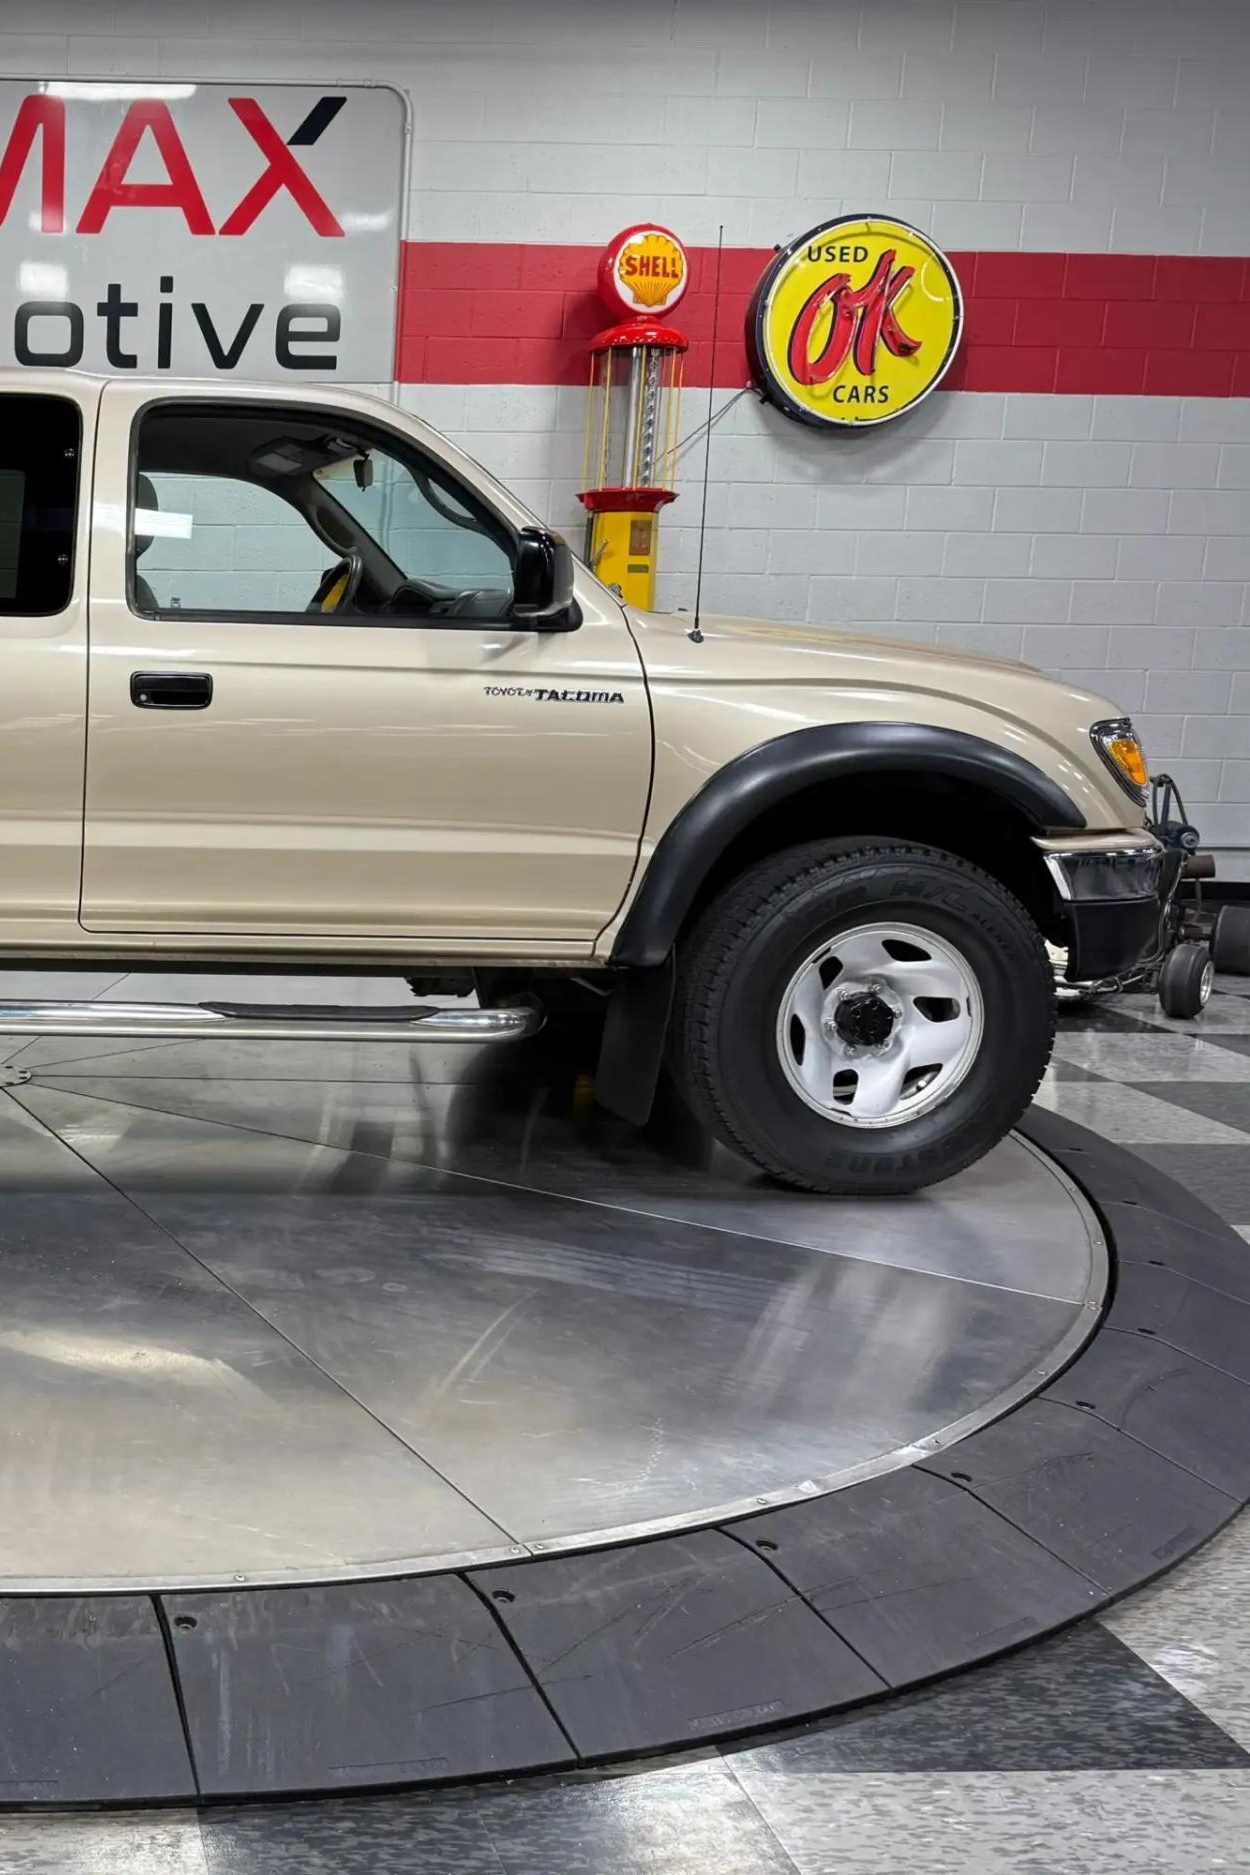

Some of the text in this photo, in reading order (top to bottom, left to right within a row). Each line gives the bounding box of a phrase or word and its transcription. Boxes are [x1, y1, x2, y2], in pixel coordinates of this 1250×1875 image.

[807, 245, 869, 263] USED
[625, 254, 679, 279] SHELL
[787, 249, 922, 385] OK
[833, 385, 889, 404] CARS
[484, 687, 625, 704] TOYOTA TACOMA
